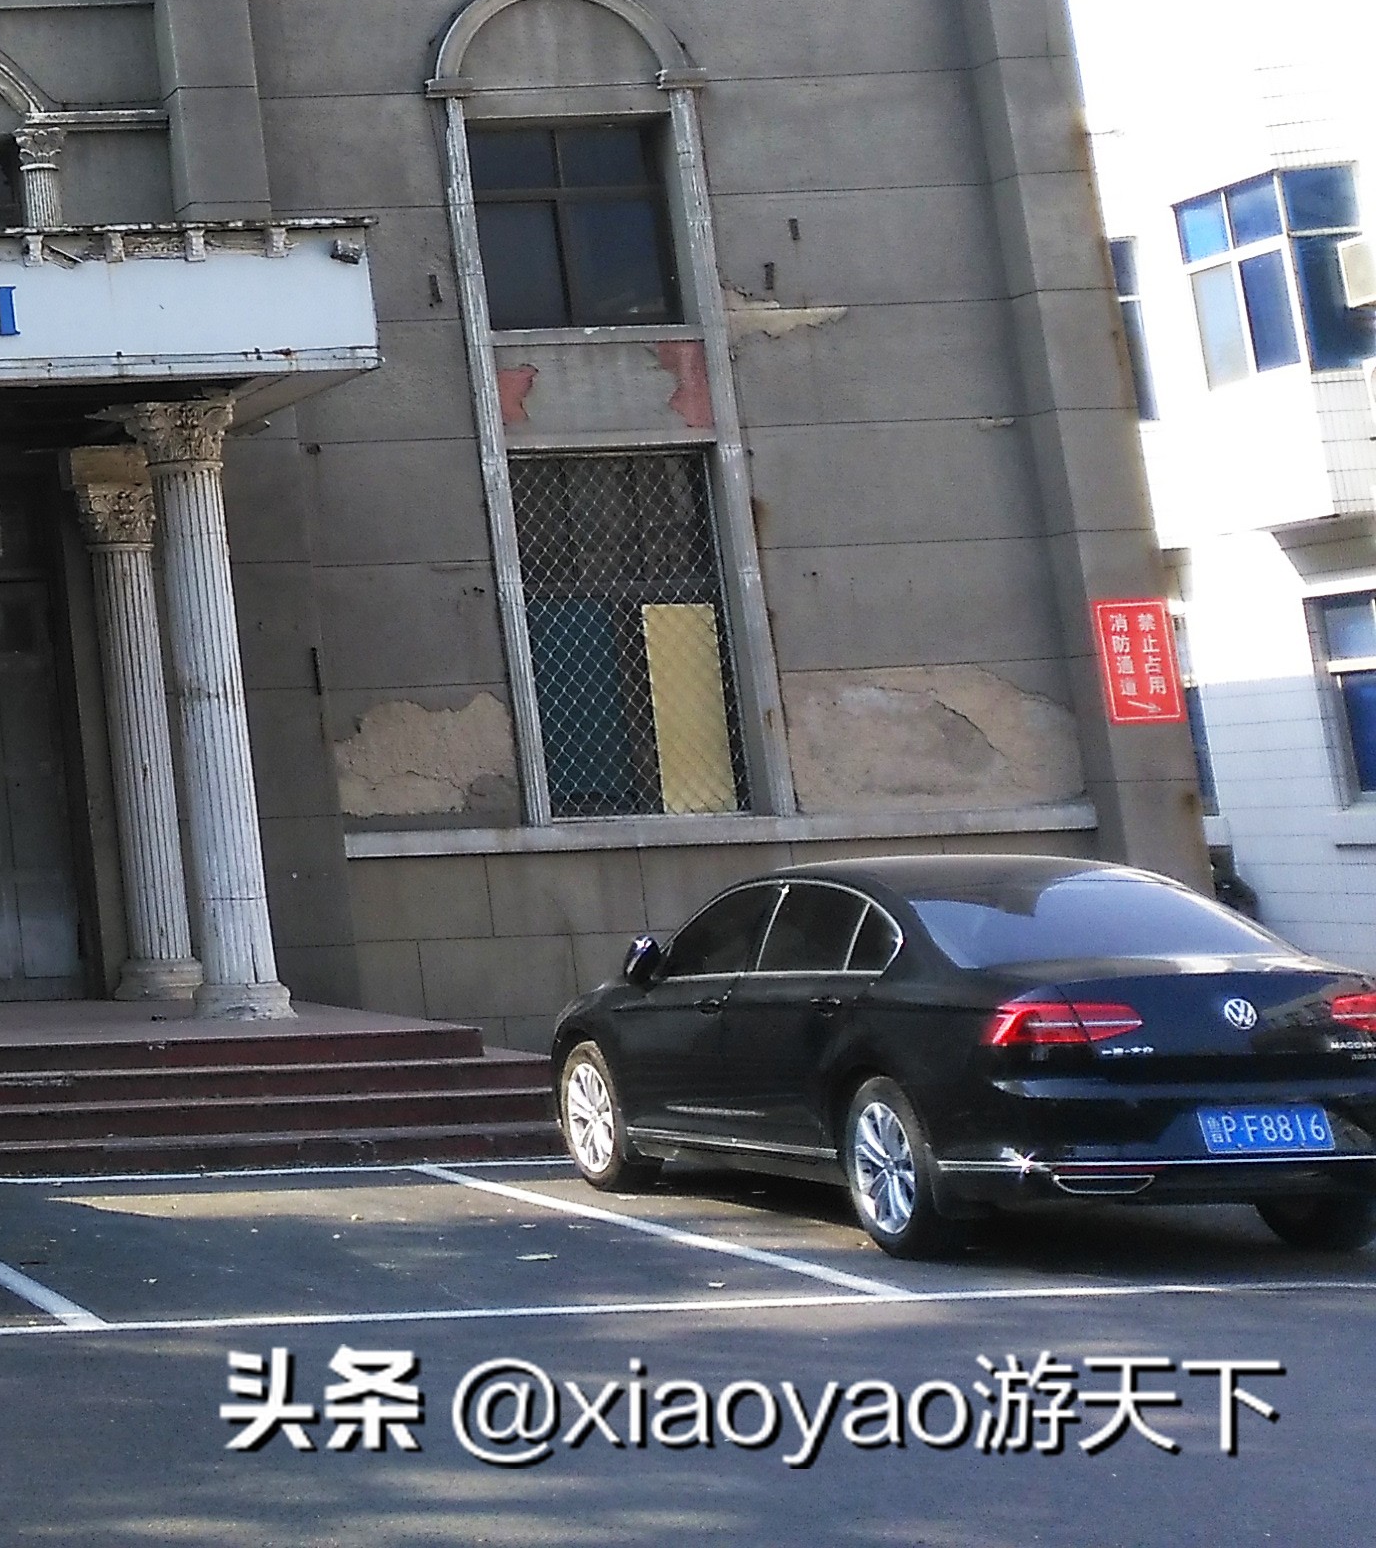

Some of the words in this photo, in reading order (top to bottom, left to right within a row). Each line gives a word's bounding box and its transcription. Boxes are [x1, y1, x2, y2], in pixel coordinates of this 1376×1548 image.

[1109, 612, 1138, 696] 消防通道
[1137, 612, 1167, 695] 禁止占用
